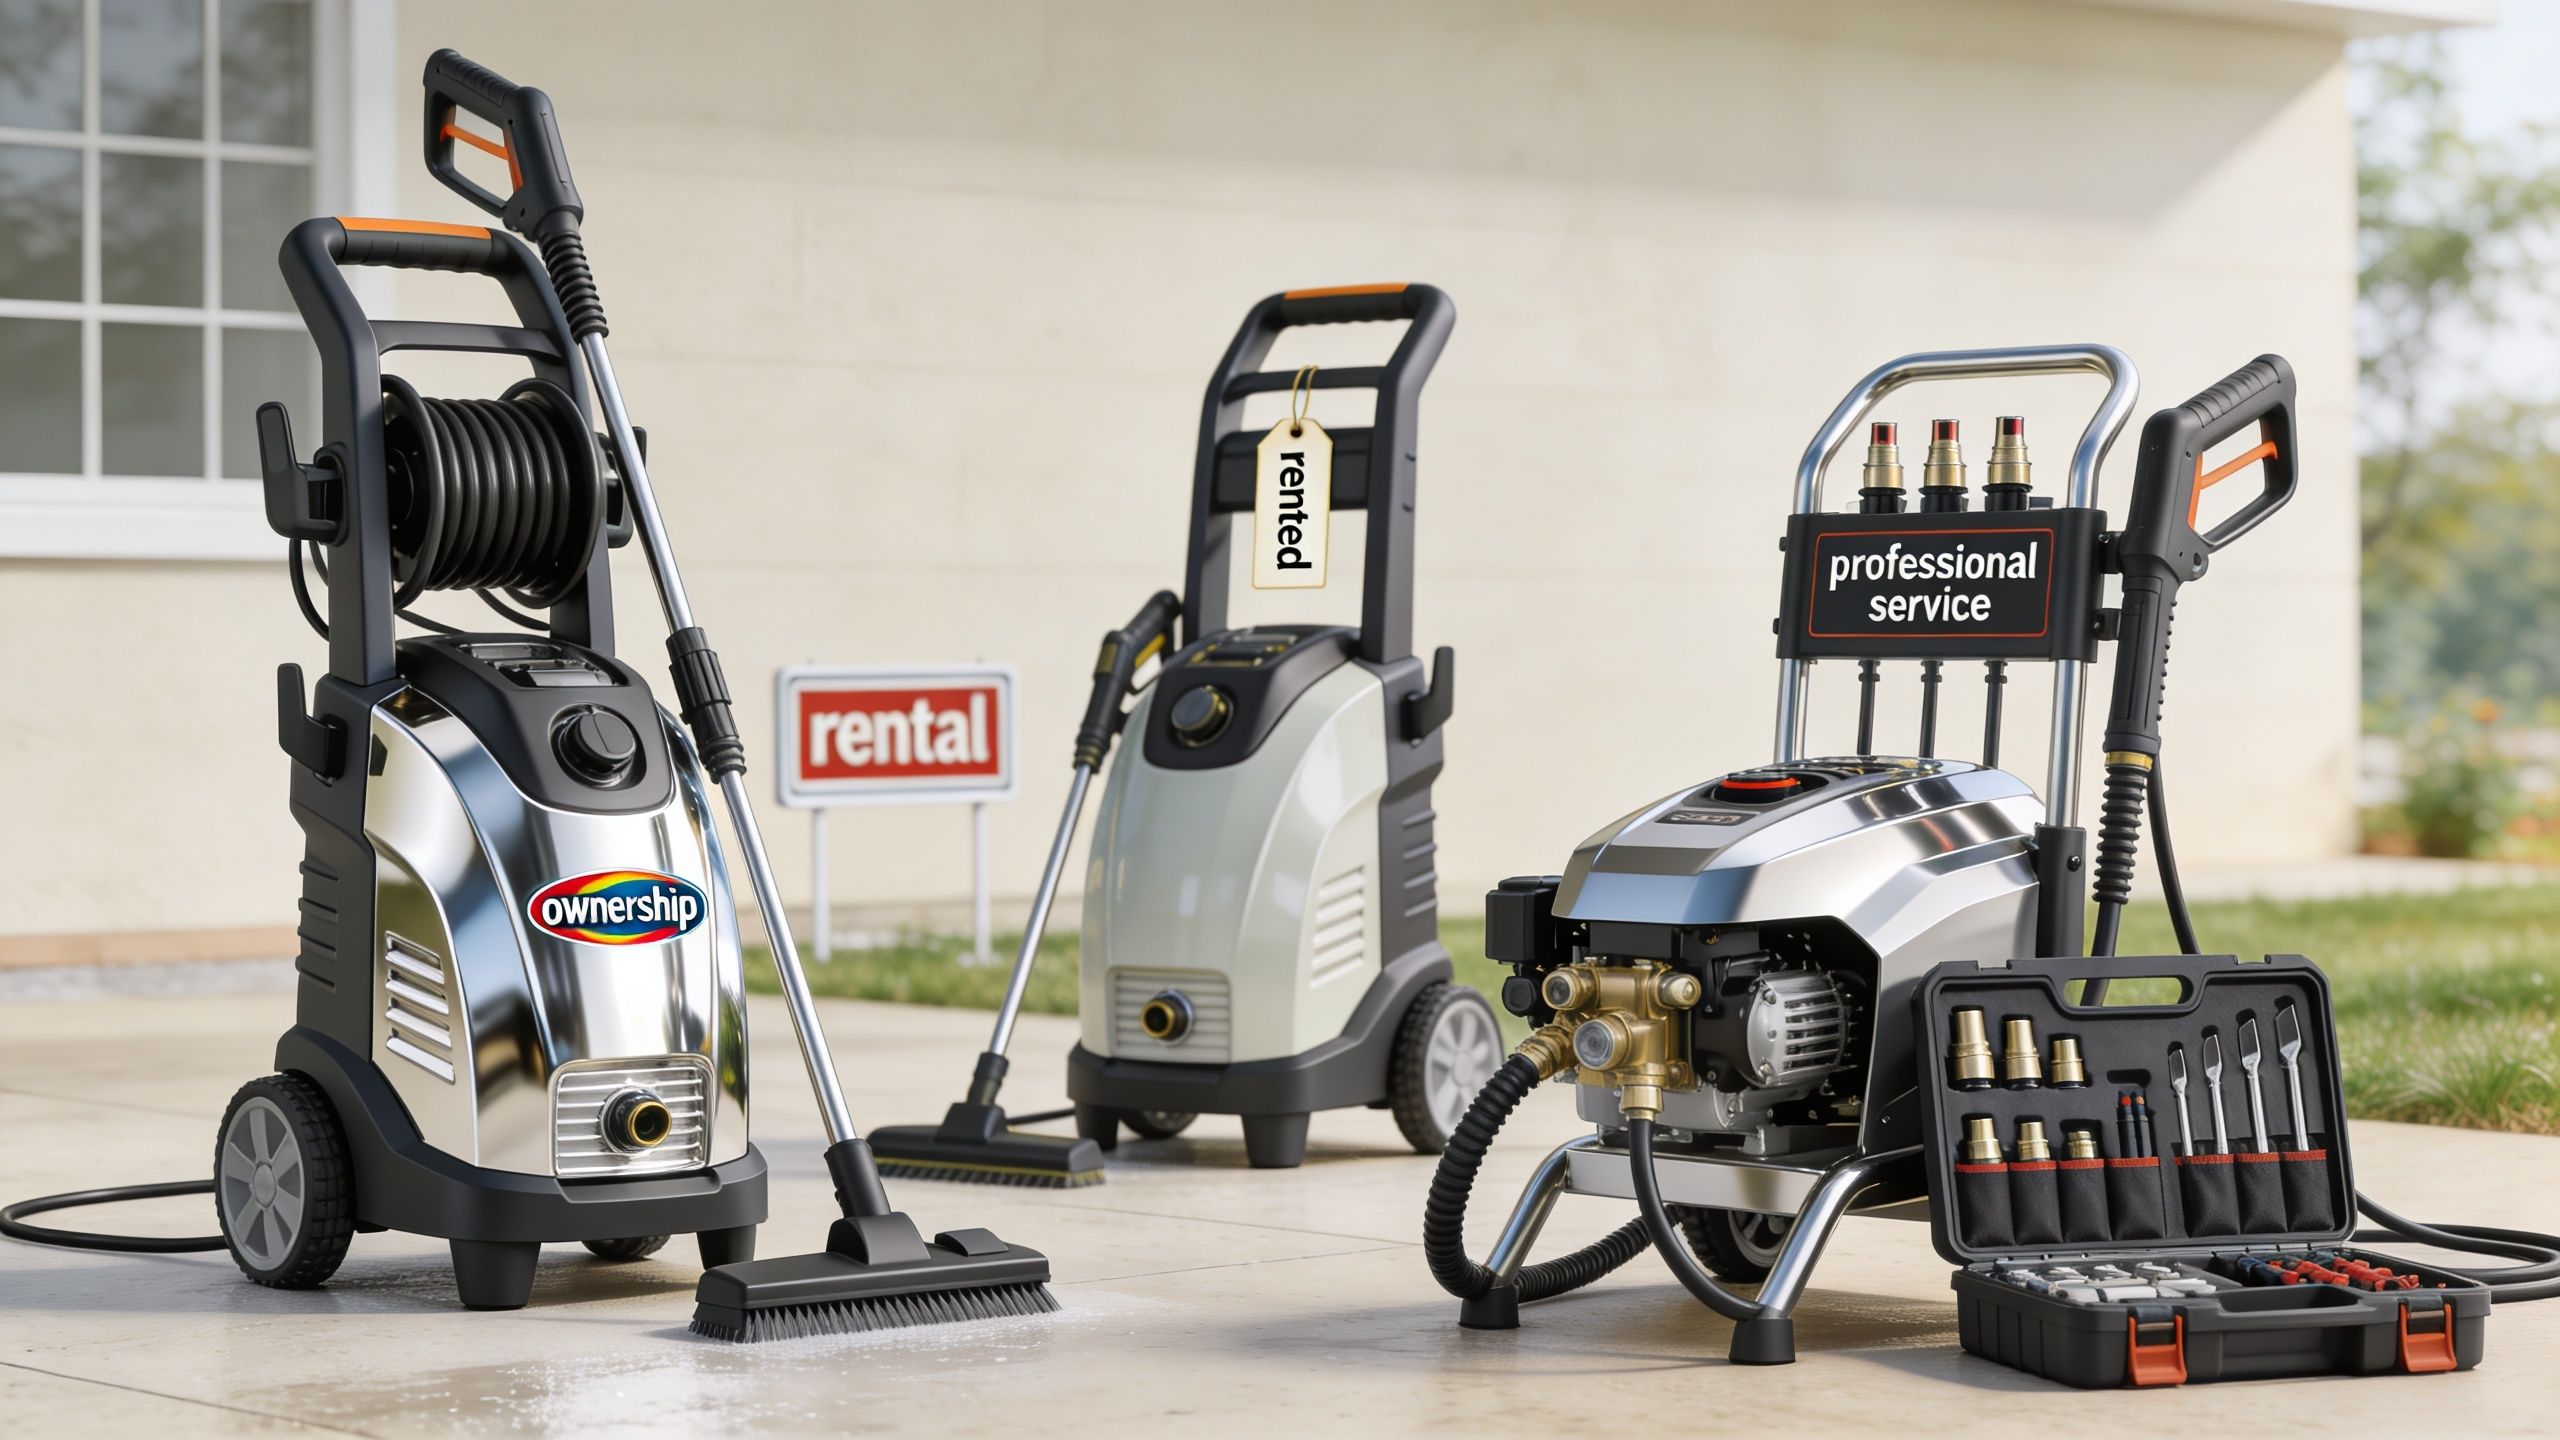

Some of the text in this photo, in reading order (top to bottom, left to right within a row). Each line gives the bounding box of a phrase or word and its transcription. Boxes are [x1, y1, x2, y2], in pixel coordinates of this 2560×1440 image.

[1277, 452, 1312, 570] rented
[1829, 541, 2038, 591] professional
[1868, 585, 1992, 622] service
[810, 691, 990, 767] rental
[542, 886, 698, 931] ownership
